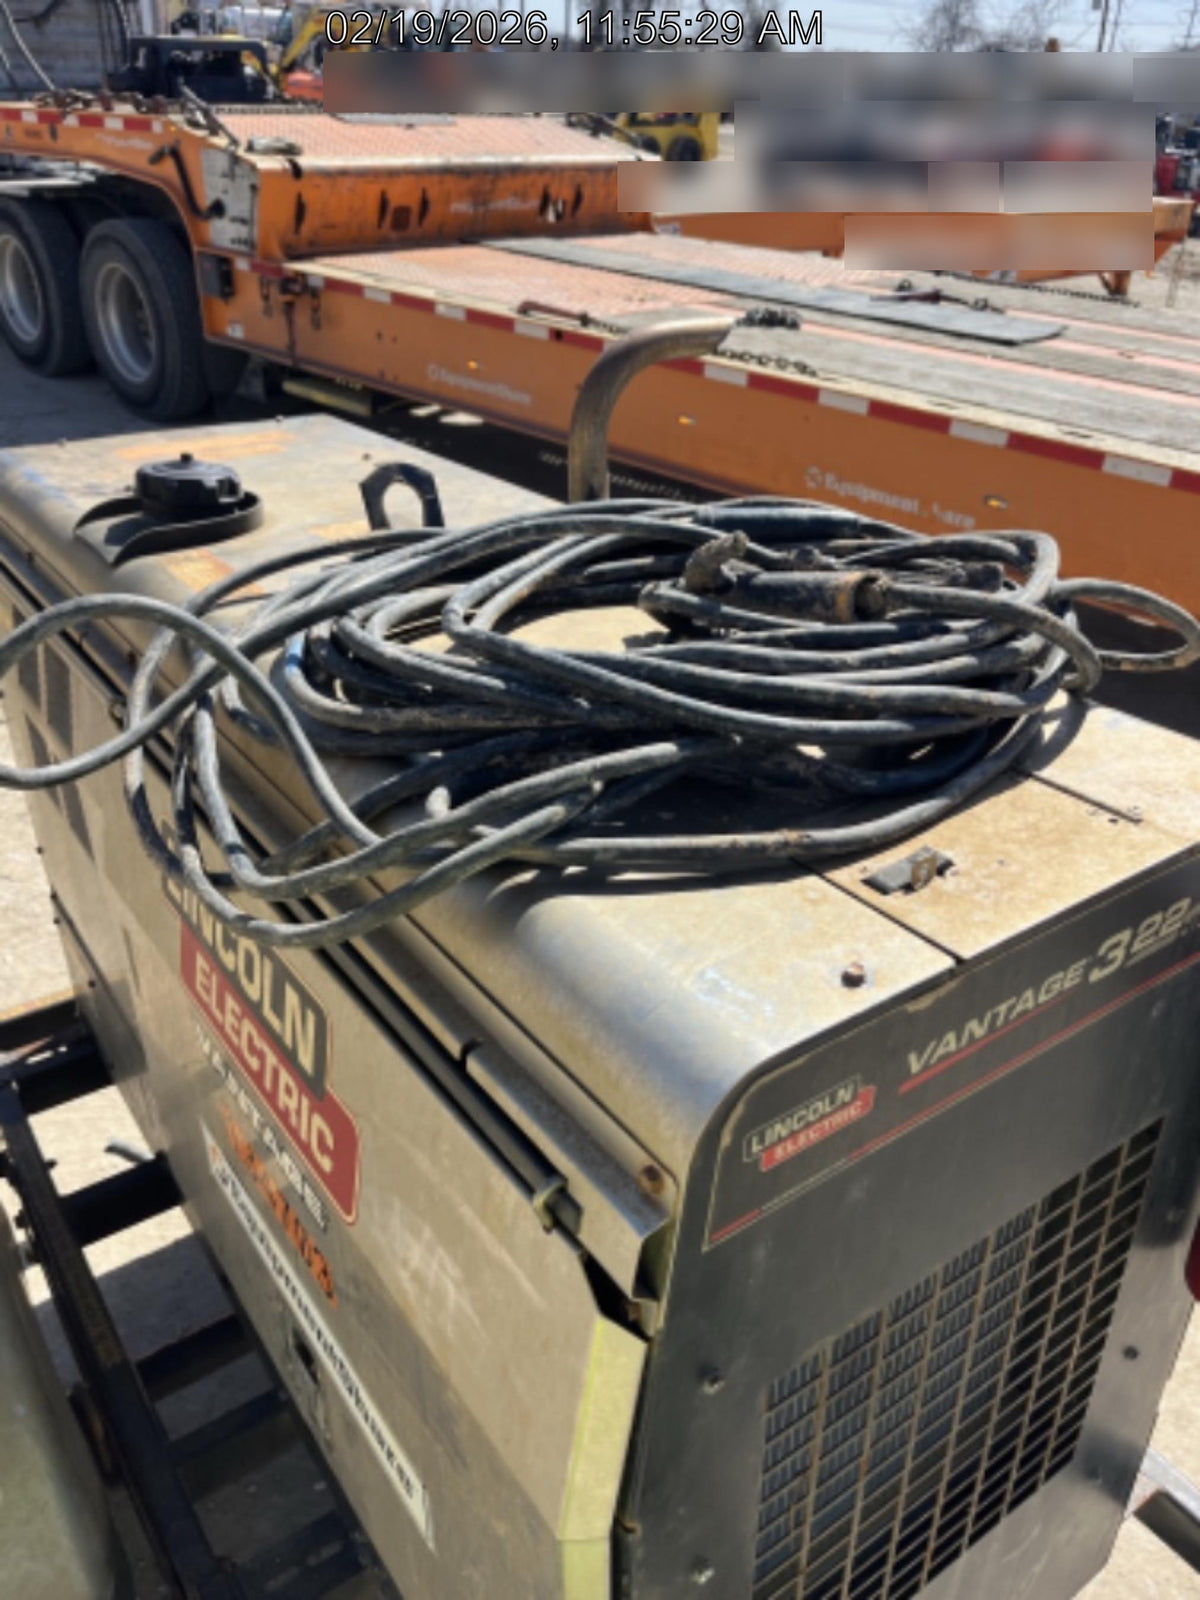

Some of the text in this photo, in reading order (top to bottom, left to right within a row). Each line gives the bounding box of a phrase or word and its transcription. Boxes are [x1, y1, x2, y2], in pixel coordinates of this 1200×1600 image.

[906, 896, 1193, 1077] VANTAGE 322
[194, 950, 335, 1174] ELECTRIC
[751, 1082, 856, 1154] LINCOLN
[773, 1099, 864, 1160] ELECTRIC
